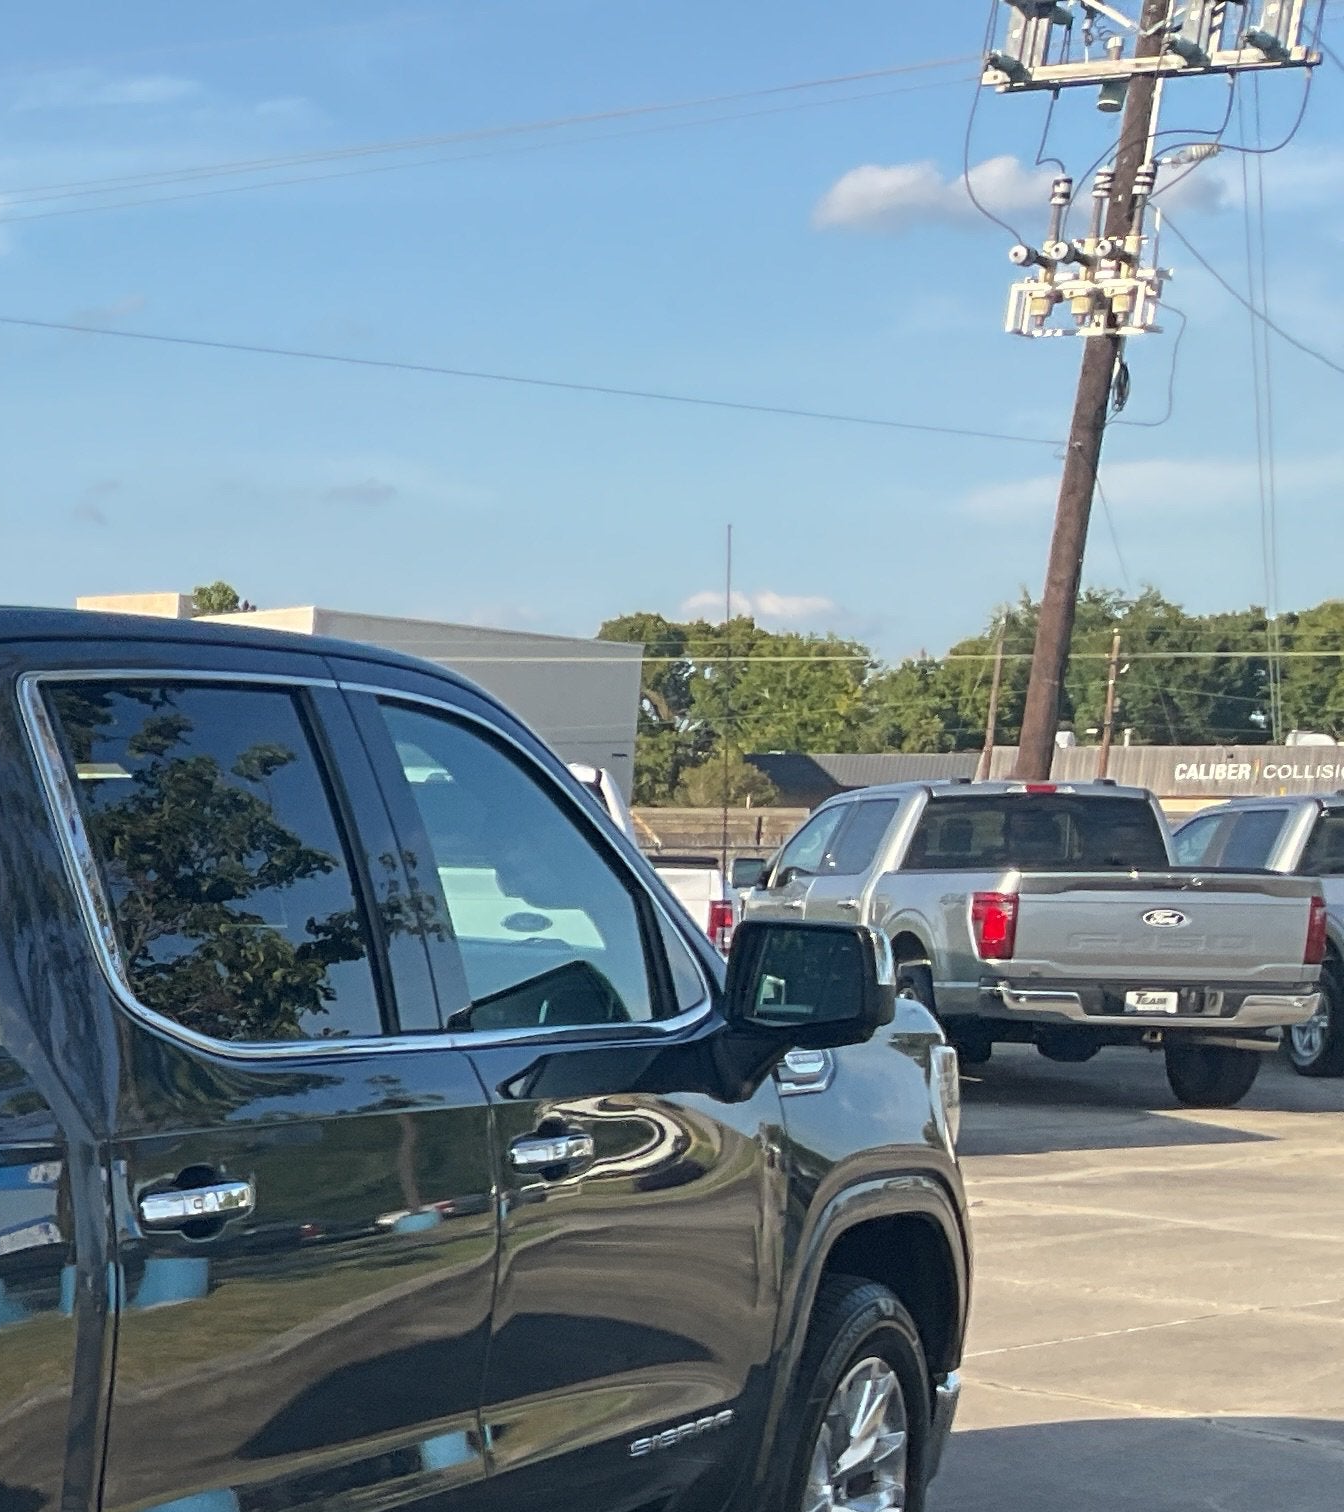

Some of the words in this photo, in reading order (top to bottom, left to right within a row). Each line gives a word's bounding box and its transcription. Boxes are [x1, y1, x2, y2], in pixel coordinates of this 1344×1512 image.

[1174, 763, 1252, 780] CALIBER
[1263, 764, 1344, 779] COLLISI
[630, 1409, 733, 1457] SIERRA
